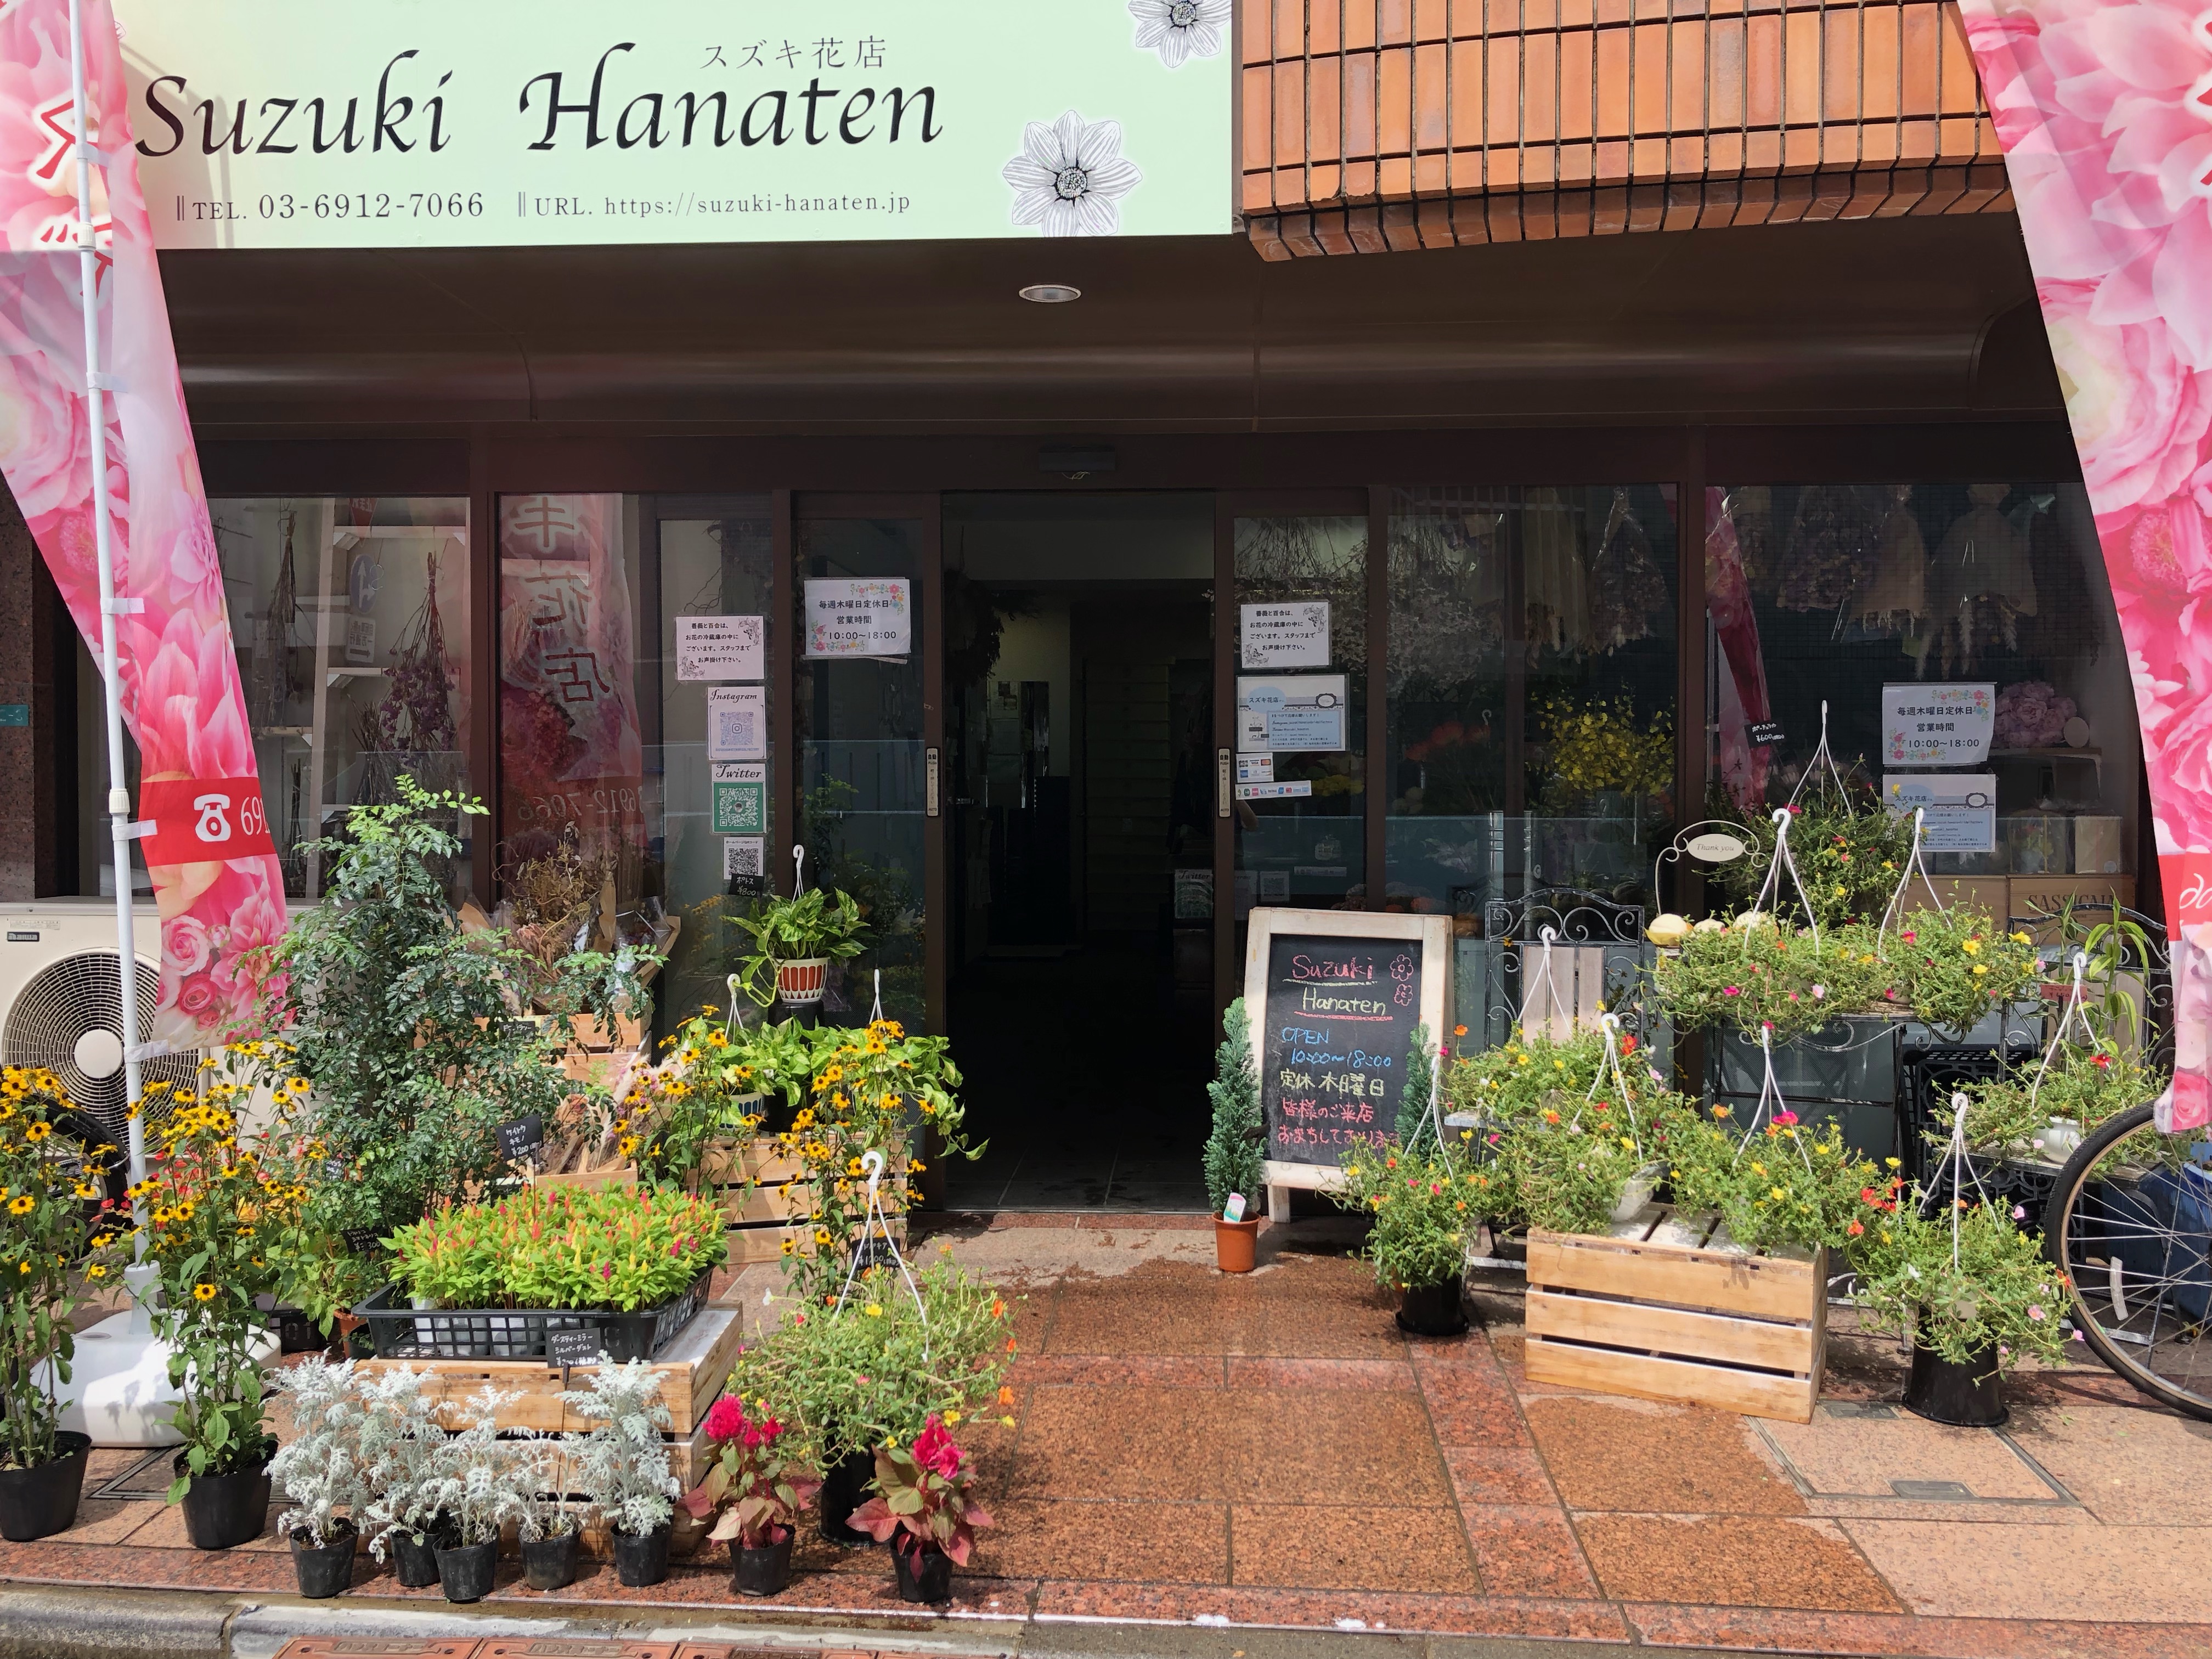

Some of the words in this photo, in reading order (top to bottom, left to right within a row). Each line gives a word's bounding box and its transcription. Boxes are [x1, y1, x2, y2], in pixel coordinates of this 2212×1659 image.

[699, 35, 887, 70] スズキ花店
[135, 49, 453, 157] Suzuki
[519, 42, 944, 151] Hanaten
[192, 201, 248, 220] TEL.
[259, 192, 484, 219] 03-6912-7066
[534, 196, 593, 217] URL.
[604, 191, 911, 218] https://suzuki-hanaten.jp
[819, 599, 889, 610] 毎週木曜日定休日
[836, 615, 872, 625] 営業時間
[709, 689, 757, 703] Instagram
[1897, 706, 1973, 716] 毎週木曜日定休日
[1916, 723, 1955, 732] 営業時間
[715, 764, 762, 778] Twitter
[736, 876, 754, 885] ポトス
[737, 885, 757, 896] ¥800
[1291, 954, 1374, 980] Suzuki
[1302, 986, 1386, 1015] Hanaten
[1282, 1026, 1330, 1045] OPEN
[1282, 1098, 1374, 1122] 皆様のご来店
[506, 1125, 526, 1137] ケイトウ
[509, 1135, 524, 1146] キモノ
